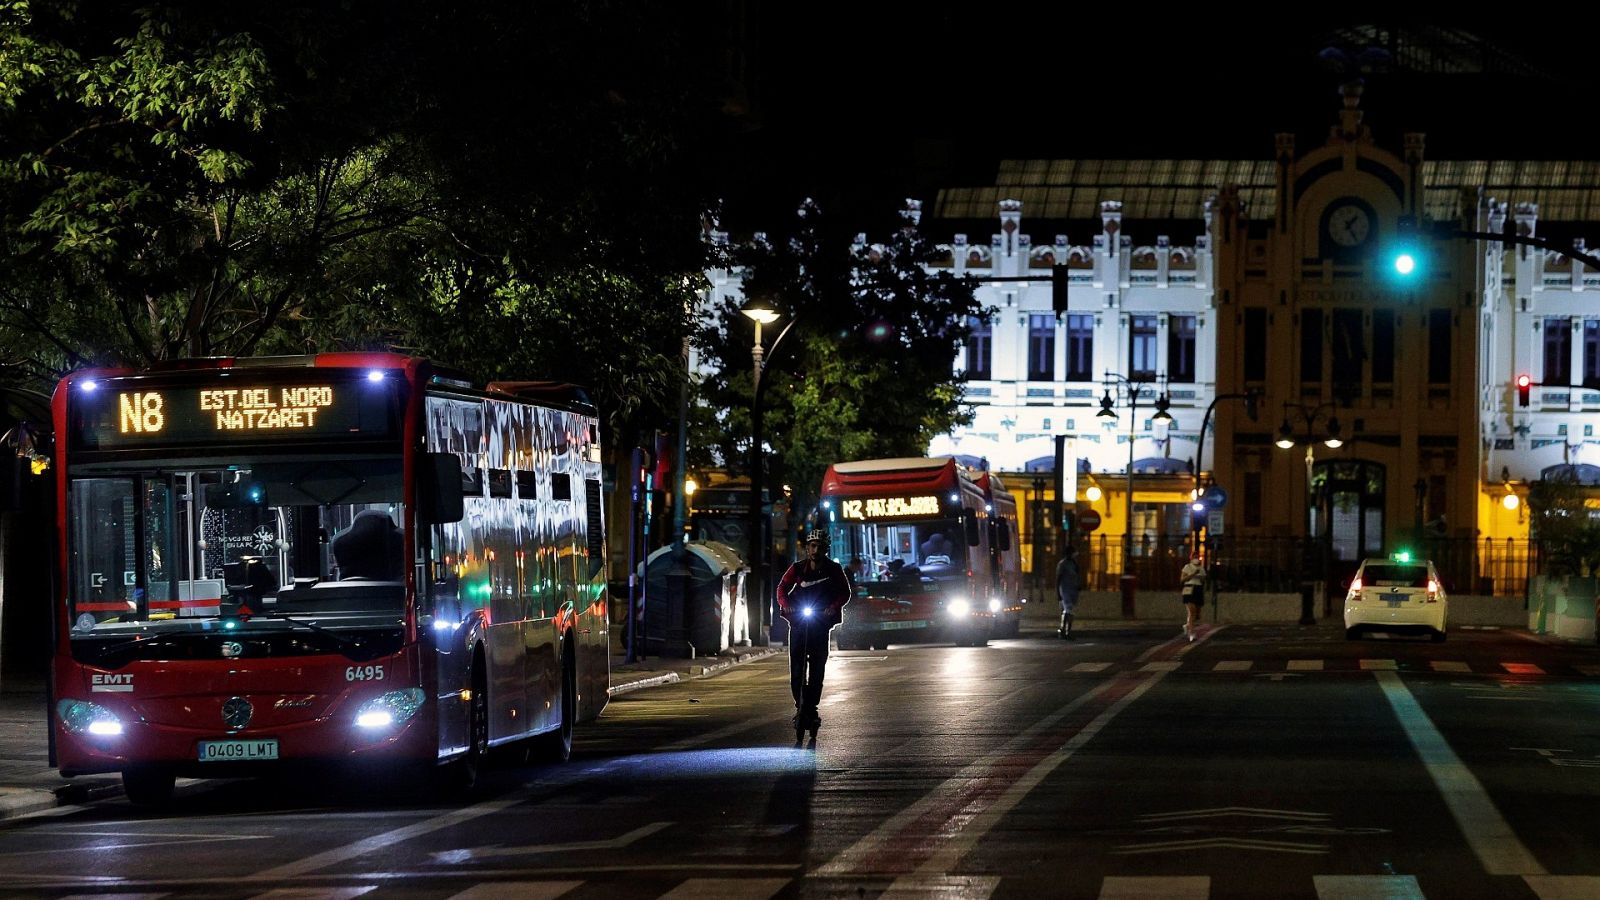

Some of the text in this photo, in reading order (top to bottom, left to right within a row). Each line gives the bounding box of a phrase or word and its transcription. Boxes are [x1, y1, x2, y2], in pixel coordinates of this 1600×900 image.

[200, 386, 332, 410] EST.DEL NORD
[119, 392, 163, 433] N8
[216, 407, 317, 430] NATZARET
[91, 673, 134, 685] EMT
[345, 665, 385, 682] 6495
[207, 742, 275, 758] 0409 LMT
